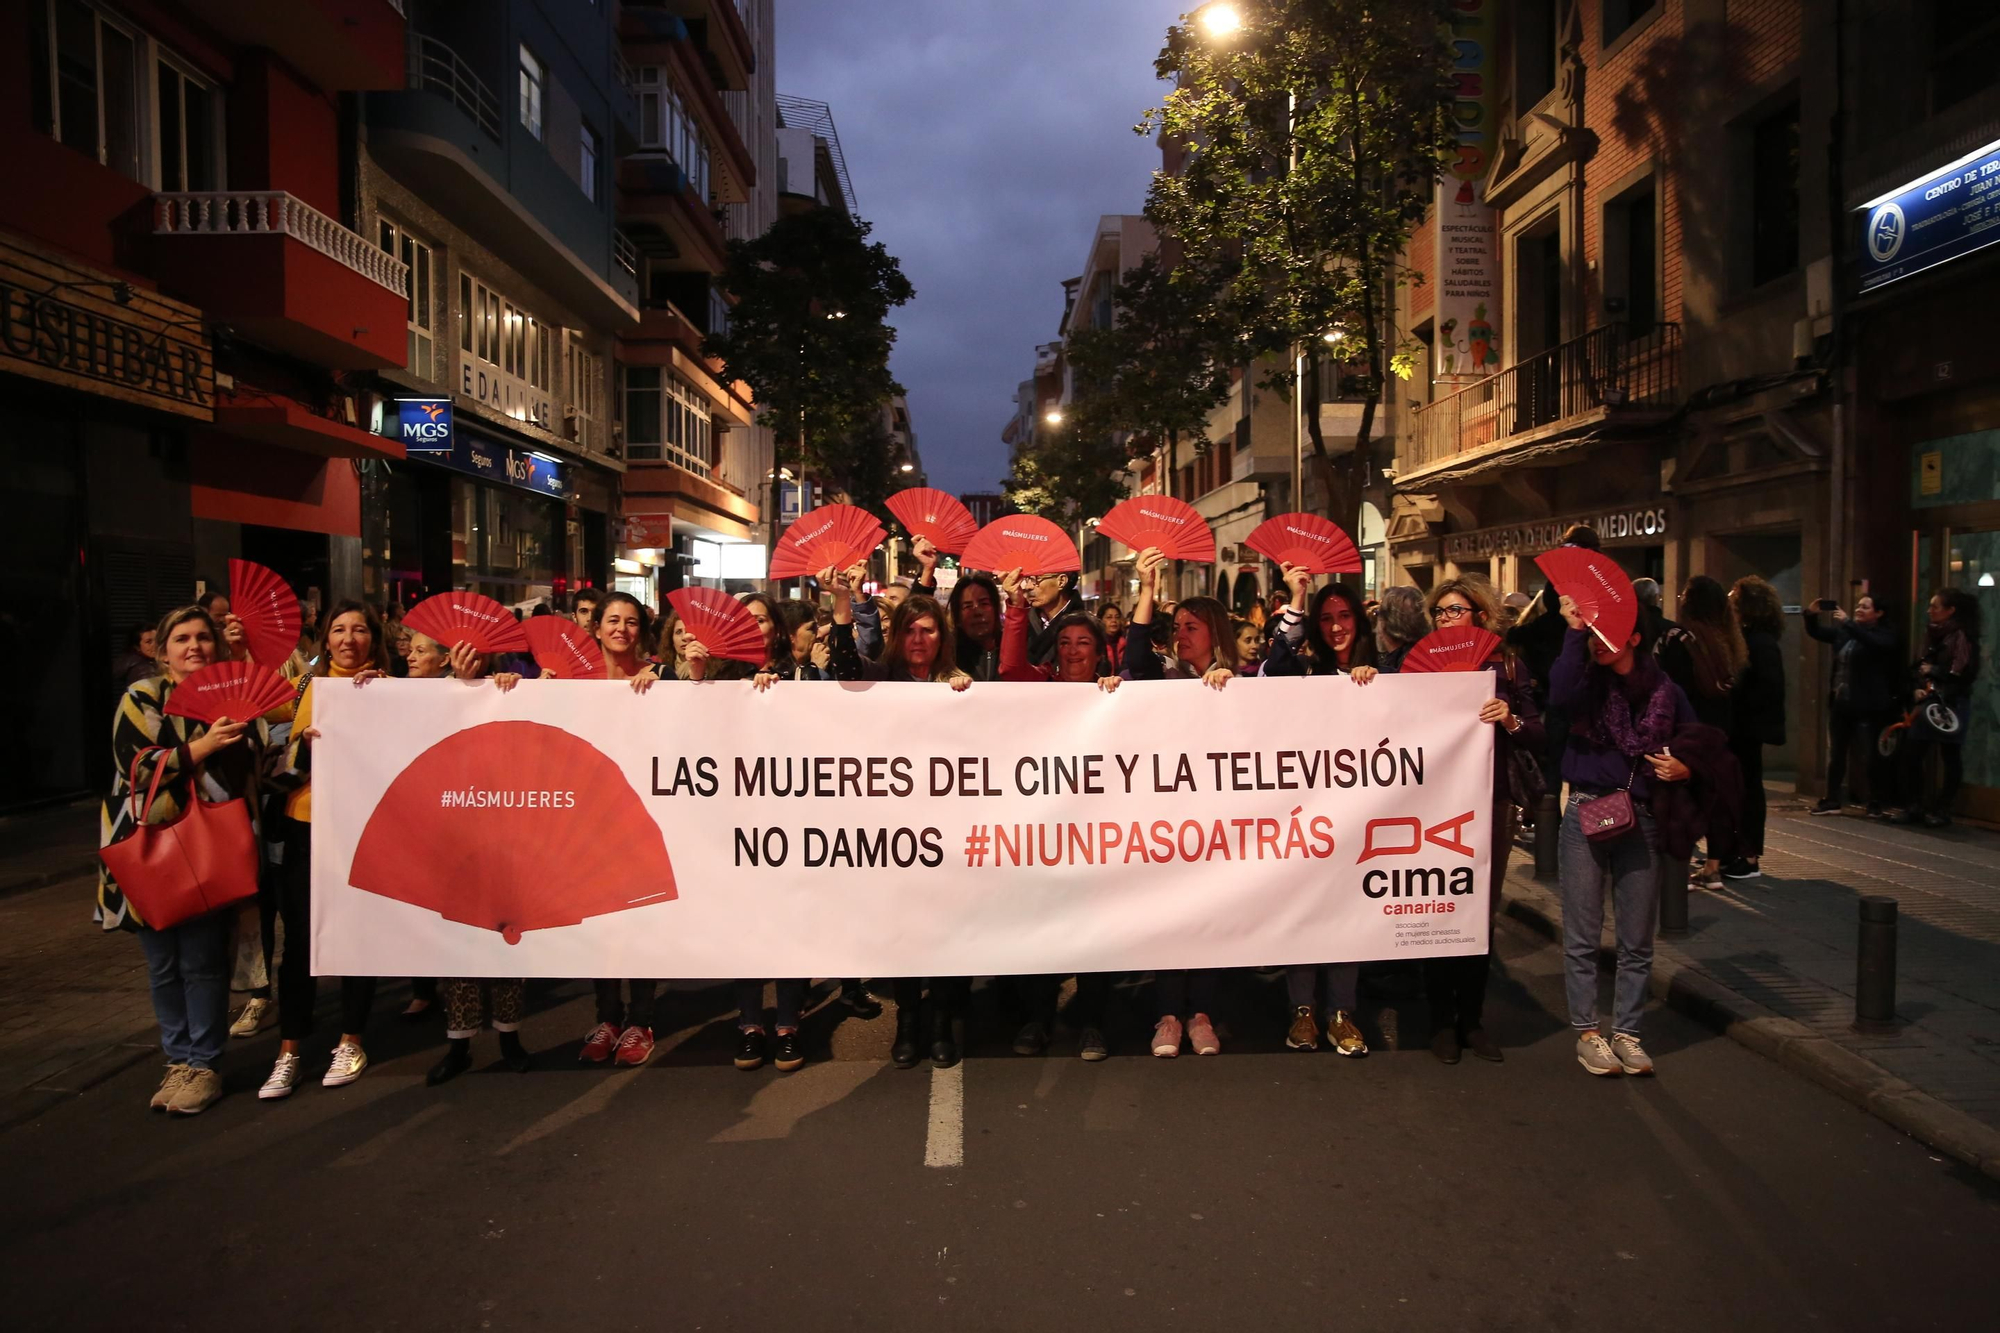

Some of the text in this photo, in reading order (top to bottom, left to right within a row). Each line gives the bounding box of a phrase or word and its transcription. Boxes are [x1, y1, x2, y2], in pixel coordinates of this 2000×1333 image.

[1925, 160, 2000, 201] CENTRO DE TER
[1969, 178, 1992, 196] JUAN
[1962, 207, 1982, 225] JOSÉ
[1442, 225, 1495, 233] ESPECTÁCULO
[1451, 268, 1484, 276] HÁBITOS
[1444, 279, 1491, 287] SALUDABLES
[1467, 289, 1490, 298] NIÑOS
[403, 423, 449, 438] MGS
[471, 450, 563, 490] Seguros MGS Seguros
[1140, 509, 1185, 525] #MÁSMUJERES
[1597, 508, 1666, 539] MEDICOS
[795, 519, 834, 547] #MÁSMUJERES
[1002, 529, 1049, 542] #MÁSMUJERES
[1286, 525, 1330, 544] #MÁSMUJERES
[1587, 564, 1622, 603] #MÁSMUJERES
[452, 603, 500, 623] #MÁSMUJERES
[560, 632, 594, 671] #MÁSMUJERES
[1429, 640, 1474, 654] #MÁSMUJERES
[651, 737, 1424, 797] LAS MUJERES DEL CINE Y LA TELEVISIÓN
[441, 786, 575, 808] #MÁSMUJERES
[734, 805, 1335, 868] NO DAMOS #NIUNPASOATRÁS
[1362, 866, 1474, 899] cima
[1383, 900, 1455, 915] canarias
[1405, 930, 1430, 938] mujeres
[1431, 928, 1461, 936] cineastas
[1410, 938, 1433, 946] medios
[1435, 936, 1476, 945] audiovisuales
